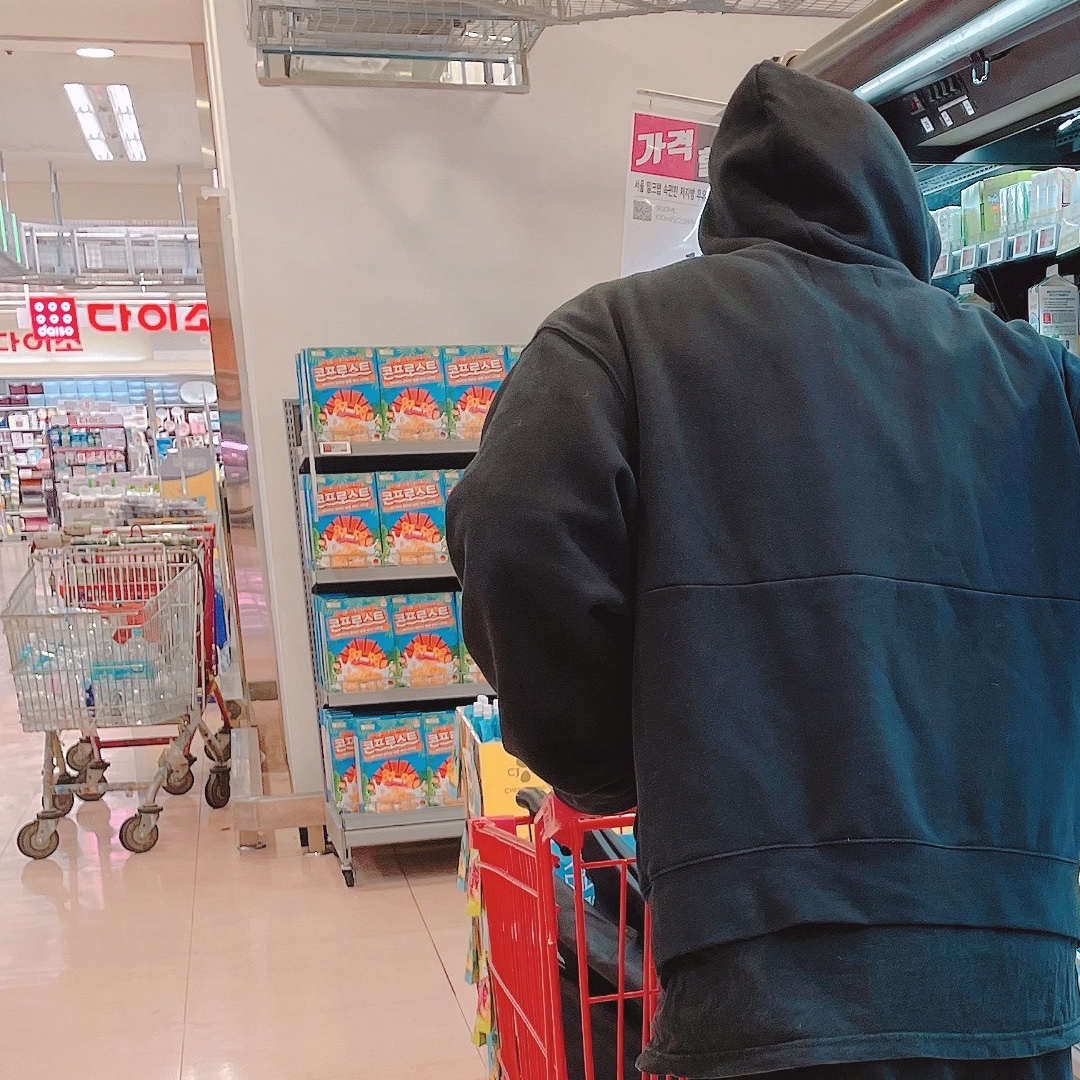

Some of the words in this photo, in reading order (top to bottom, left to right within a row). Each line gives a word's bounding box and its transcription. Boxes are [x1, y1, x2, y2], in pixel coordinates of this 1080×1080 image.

[635, 128, 695, 167] 가격
[87, 301, 210, 332] 다이소
[37, 325, 74, 338] daiso
[381, 360, 439, 381] 콘프로스트
